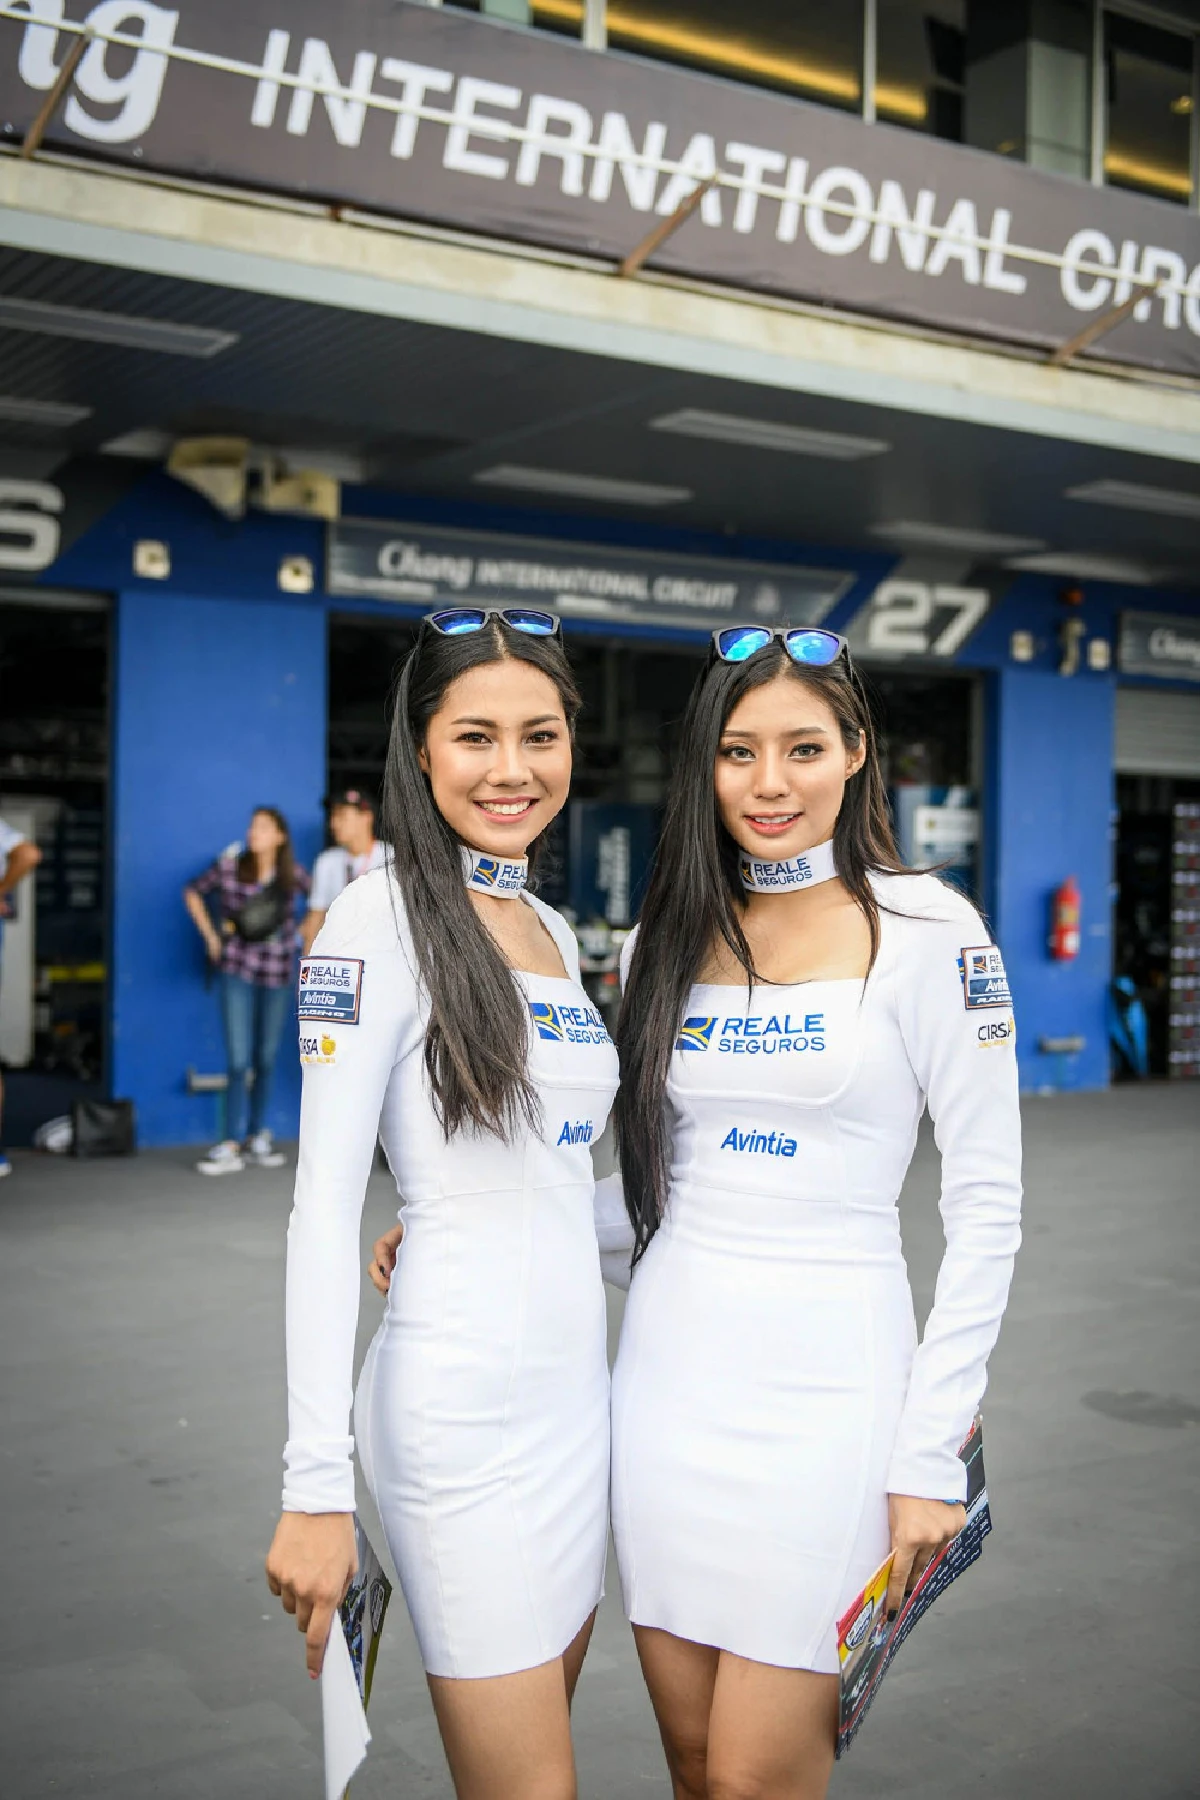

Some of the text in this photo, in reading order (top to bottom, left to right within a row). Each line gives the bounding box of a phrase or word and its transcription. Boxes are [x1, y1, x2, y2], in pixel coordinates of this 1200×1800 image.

[251, 29, 1027, 295] INTERNATIONAL
[1060, 228, 1200, 338] CIR
[378, 539, 739, 609] Chang INTERNATIONAL CIRCUIT
[868, 578, 990, 656] 27
[753, 857, 811, 876] REALE
[757, 870, 813, 885] SEGUROS
[310, 966, 351, 979] REALE
[310, 977, 351, 987] SEGUROS
[721, 1013, 825, 1037] REALE
[718, 1037, 826, 1054] SEGUROS
